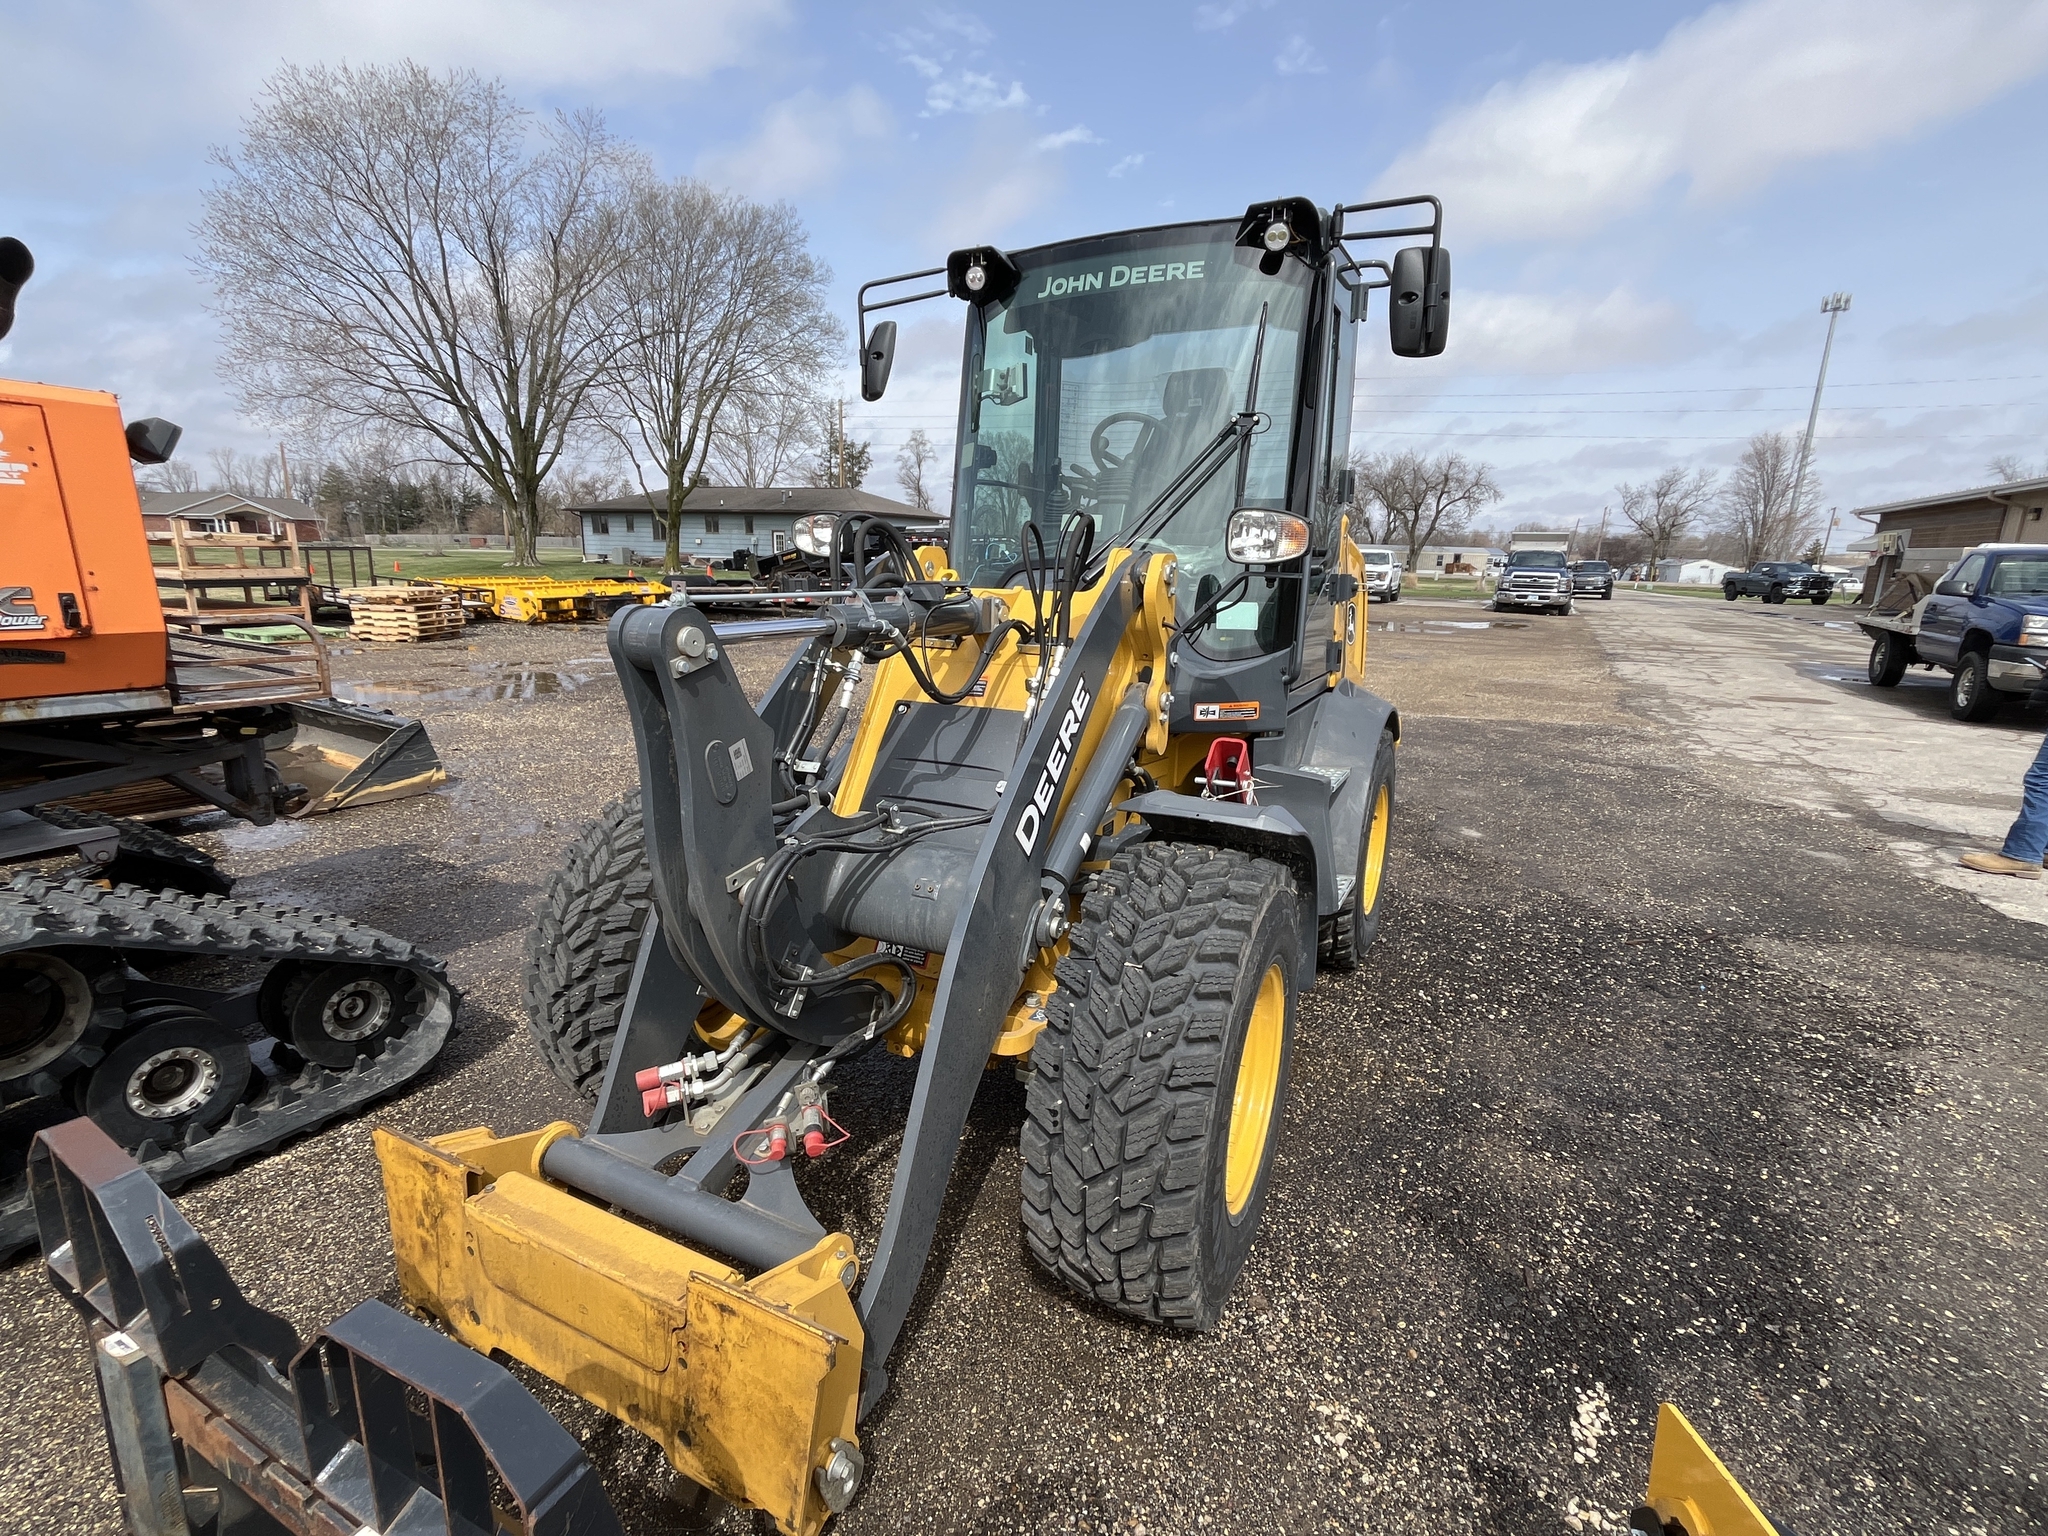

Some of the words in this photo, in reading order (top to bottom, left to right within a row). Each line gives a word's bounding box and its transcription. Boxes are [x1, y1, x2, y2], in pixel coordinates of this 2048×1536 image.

[1037, 272, 1103, 299] JOHN
[1109, 260, 1205, 288] DEERE
[0, 615, 48, 626] ower
[1014, 675, 1091, 858] DEERE
